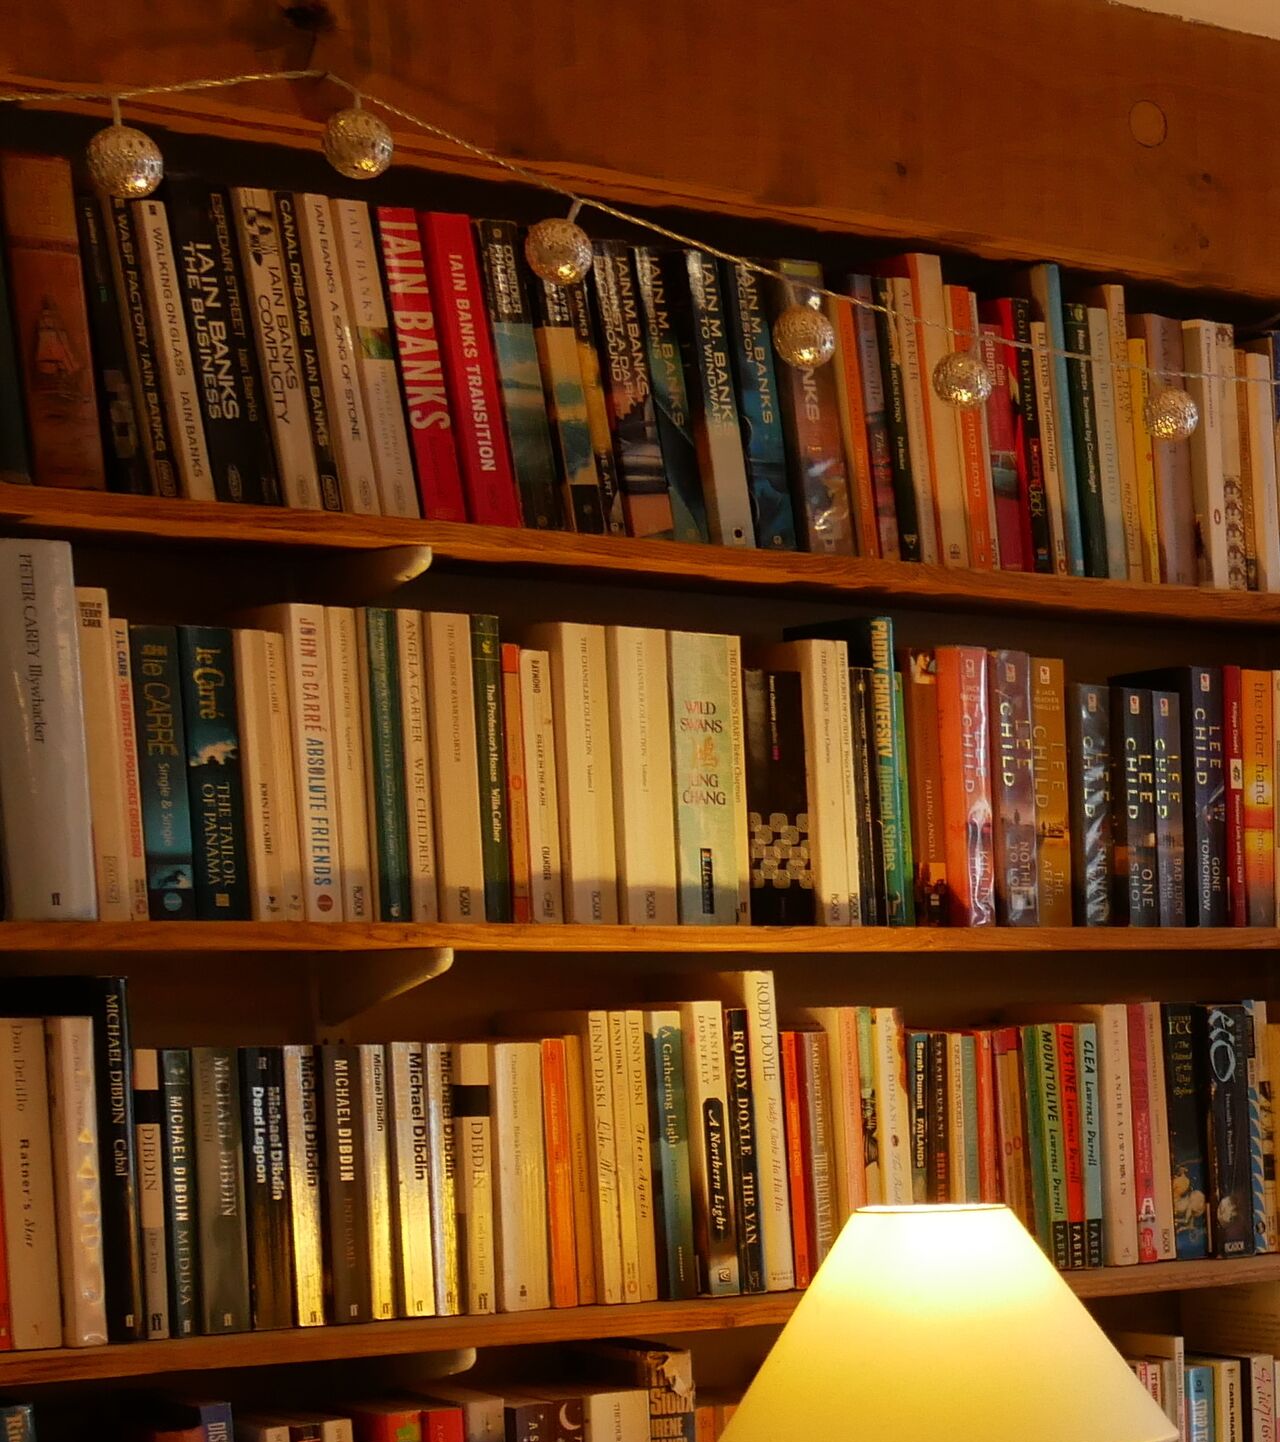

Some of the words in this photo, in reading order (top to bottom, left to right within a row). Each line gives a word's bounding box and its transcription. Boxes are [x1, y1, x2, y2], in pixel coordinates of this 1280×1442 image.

[280, 199, 299, 257] CANAL
[153, 227, 174, 301] WALKING
[181, 243, 201, 289] THE
[193, 242, 222, 308] IAIN
[269, 266, 285, 304] IAIN
[380, 220, 429, 295] IAIN
[448, 254, 468, 291] IAIN
[289, 260, 311, 337] DREAMS
[701, 263, 717, 312] IAIN
[169, 328, 186, 376] GLASS
[275, 308, 299, 390] BANKS
[319, 238, 337, 293] BANKS
[343, 389, 361, 440] STONE
[455, 298, 478, 359] BANKS
[190, 299, 223, 420] BUSINESS
[206, 321, 240, 420] BANKS
[258, 294, 291, 424] COMPLICITY
[302, 349, 319, 387] IAIN
[393, 310, 450, 430] BANKS
[752, 347, 773, 424] BANKS
[145, 392, 166, 453] BANKS
[178, 391, 193, 424] IAIN
[308, 389, 328, 447] BANKS
[465, 366, 496, 472] TRANSITION
[184, 427, 202, 478] BANKS
[18, 553, 34, 603] PETER
[22, 606, 38, 658] CAREY
[194, 647, 223, 664] le
[871, 620, 888, 670] PADDY
[27, 666, 44, 744] Illywhacker
[194, 667, 225, 720] Carré
[409, 686, 423, 743] CARTER
[874, 674, 893, 758] CHAYEFSKY
[680, 718, 722, 734] SWANS
[1000, 702, 1014, 786] CHILD
[1194, 708, 1206, 784] CHILD
[1208, 725, 1220, 768] LEE
[202, 785, 216, 808] OF
[218, 784, 232, 819] THE
[306, 739, 328, 812] ABSOLUTE
[413, 759, 426, 795] WISE
[1125, 738, 1137, 819] CHILD
[1138, 755, 1152, 803] LEE
[161, 813, 174, 848] Single
[204, 813, 222, 886] PANAMA
[220, 824, 237, 888] TAILOR
[311, 817, 332, 887] FRIENDS
[416, 798, 430, 870] CHILDREN
[1130, 863, 1140, 912] SHOT
[1141, 869, 1153, 907] ONE
[105, 995, 122, 1067] MICHAEL
[756, 981, 772, 1031] RODDY
[590, 1019, 603, 1065] JENNY
[732, 1031, 748, 1090] RODDY
[761, 1036, 776, 1082] DOYLE
[1083, 1040, 1093, 1075] CLEA
[110, 1071, 125, 1125] DIBDIN
[334, 1059, 350, 1125] MICHAEL
[373, 1054, 382, 1096] Michael
[408, 1052, 423, 1121] Michael
[593, 1069, 606, 1109] DISKI
[1042, 1030, 1057, 1122] MOUNTOLIVE
[169, 1096, 184, 1162] MICHAEL
[252, 1088, 264, 1126] Dead
[375, 1098, 384, 1132] Dibdin
[737, 1099, 752, 1155] DOYLE
[114, 1140, 128, 1177] Cabal
[339, 1129, 355, 1182] DIBDIN
[411, 1125, 425, 1181] Dibdin
[472, 1121, 485, 1190] DIBDIN
[708, 1132, 722, 1190] Northern
[173, 1167, 187, 1222] DIBDIN
[219, 1152, 237, 1217] DIBDIN
[743, 1173, 755, 1208] THE
[712, 1196, 725, 1231] Light
[746, 1213, 757, 1245] VAN
[176, 1231, 191, 1305] MEDUSA
[1194, 1399, 1207, 1428] STRIP
